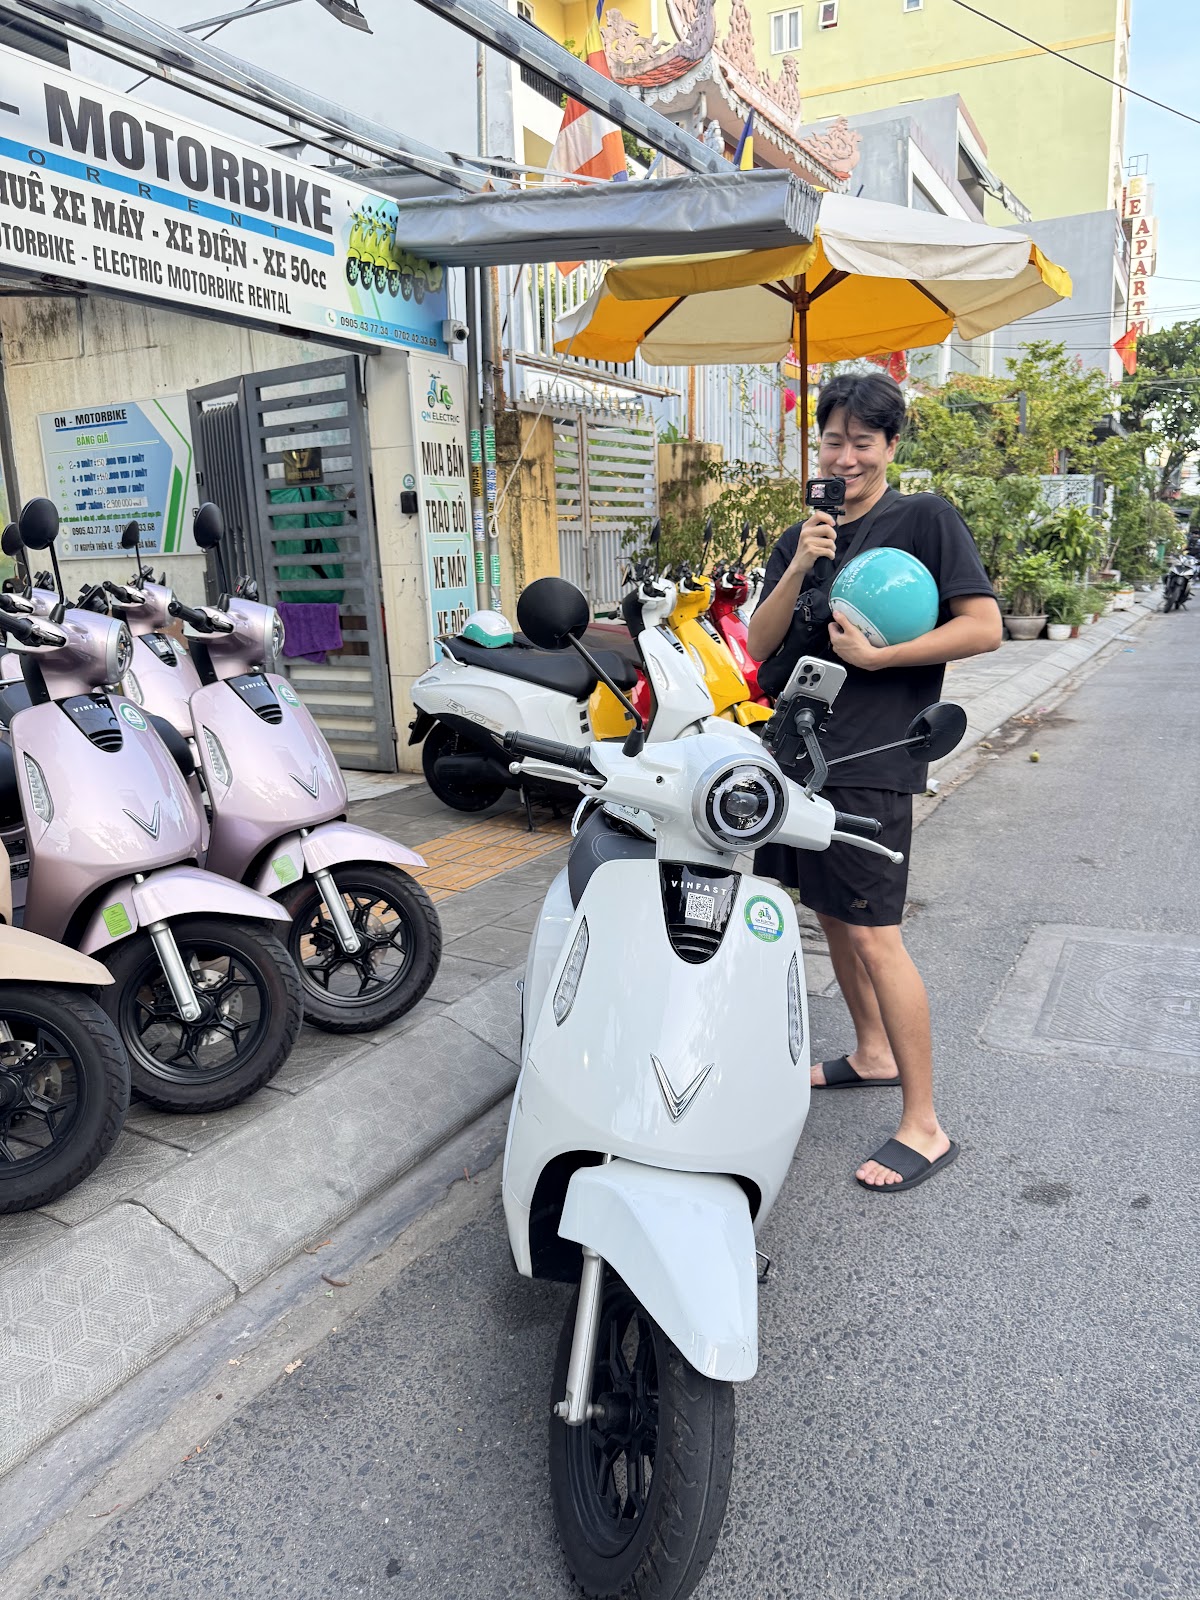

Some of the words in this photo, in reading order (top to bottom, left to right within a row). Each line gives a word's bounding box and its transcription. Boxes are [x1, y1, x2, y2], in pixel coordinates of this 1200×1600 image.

[44, 82, 333, 235] MOTORBIKE
[50, 184, 87, 226] XE
[91, 199, 145, 241] MÁY
[164, 217, 194, 255] XE
[198, 227, 248, 272] ĐIỆN
[262, 246, 288, 280] XE
[290, 255, 328, 291] 50cc
[0, 221, 76, 265] TORBIKE
[93, 245, 163, 285] ELECTRIC
[167, 263, 245, 305] MOTORBIKE
[248, 284, 292, 315] RENTAL
[54, 416, 67, 428] QN
[75, 408, 127, 426] MOTORBIKE
[421, 410, 432, 421] QN
[432, 412, 461, 423] ELECTRIC
[421, 441, 445, 476] MUA
[446, 436, 465, 478] BÁN
[425, 499, 450, 533] TRAO
[452, 490, 468, 533] ĐỔI
[433, 556, 446, 589] XE
[447, 548, 468, 588] MÁY
[73, 703, 109, 713] VINFAST
[446, 698, 487, 724] EVO
[670, 879, 728, 896] VINFAST
